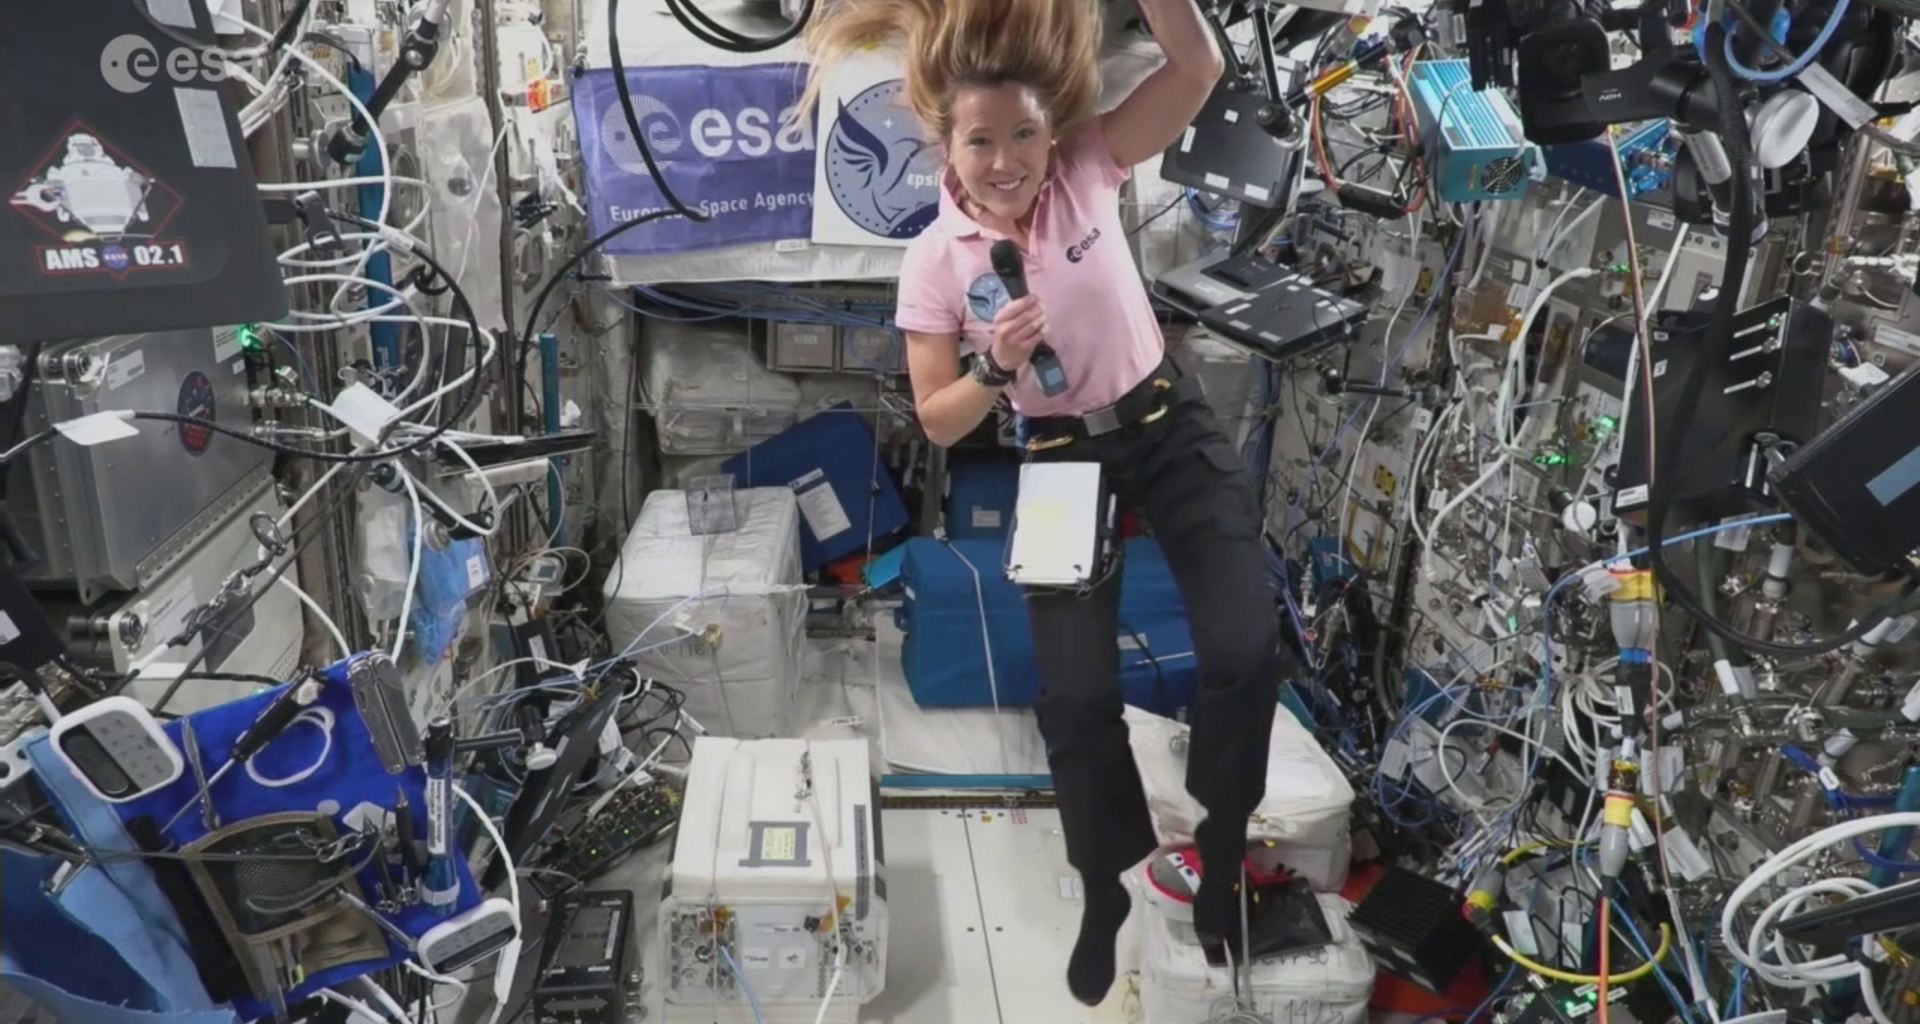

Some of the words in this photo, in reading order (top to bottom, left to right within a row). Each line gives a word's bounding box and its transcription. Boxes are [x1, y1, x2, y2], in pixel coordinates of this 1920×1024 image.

[690, 105, 817, 158] esa
[699, 198, 749, 219] Space
[754, 193, 814, 210] Agency
[1080, 227, 1102, 251] esa
[45, 248, 100, 270] AMS
[133, 244, 184, 266] 02.1
